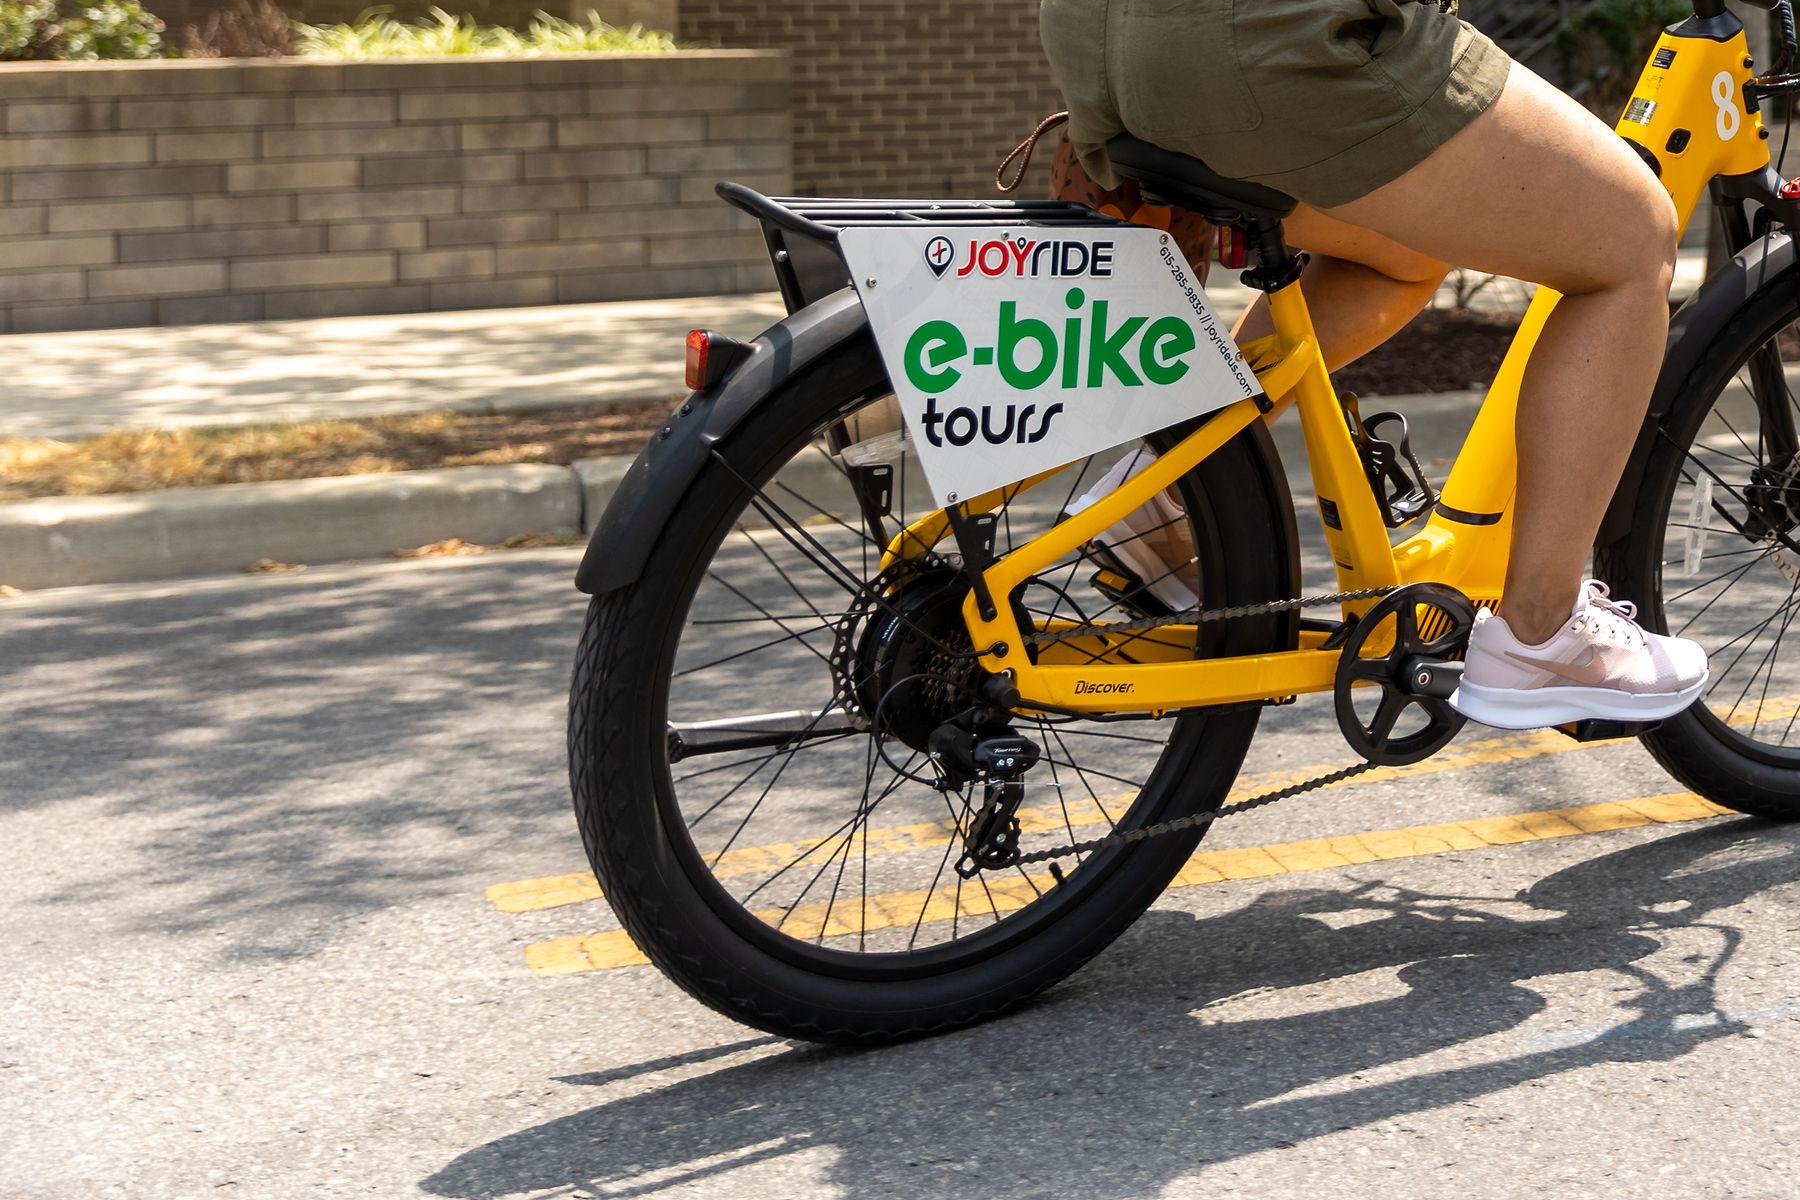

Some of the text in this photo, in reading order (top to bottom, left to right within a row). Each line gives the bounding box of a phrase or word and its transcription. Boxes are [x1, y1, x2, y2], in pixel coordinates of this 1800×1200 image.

[1711, 71, 1740, 141] 8
[904, 288, 1196, 393] e-bike
[1159, 246, 1205, 316] 615-285-9835
[1204, 322, 1253, 396] joyrideus.com
[922, 398, 1064, 448] tours
